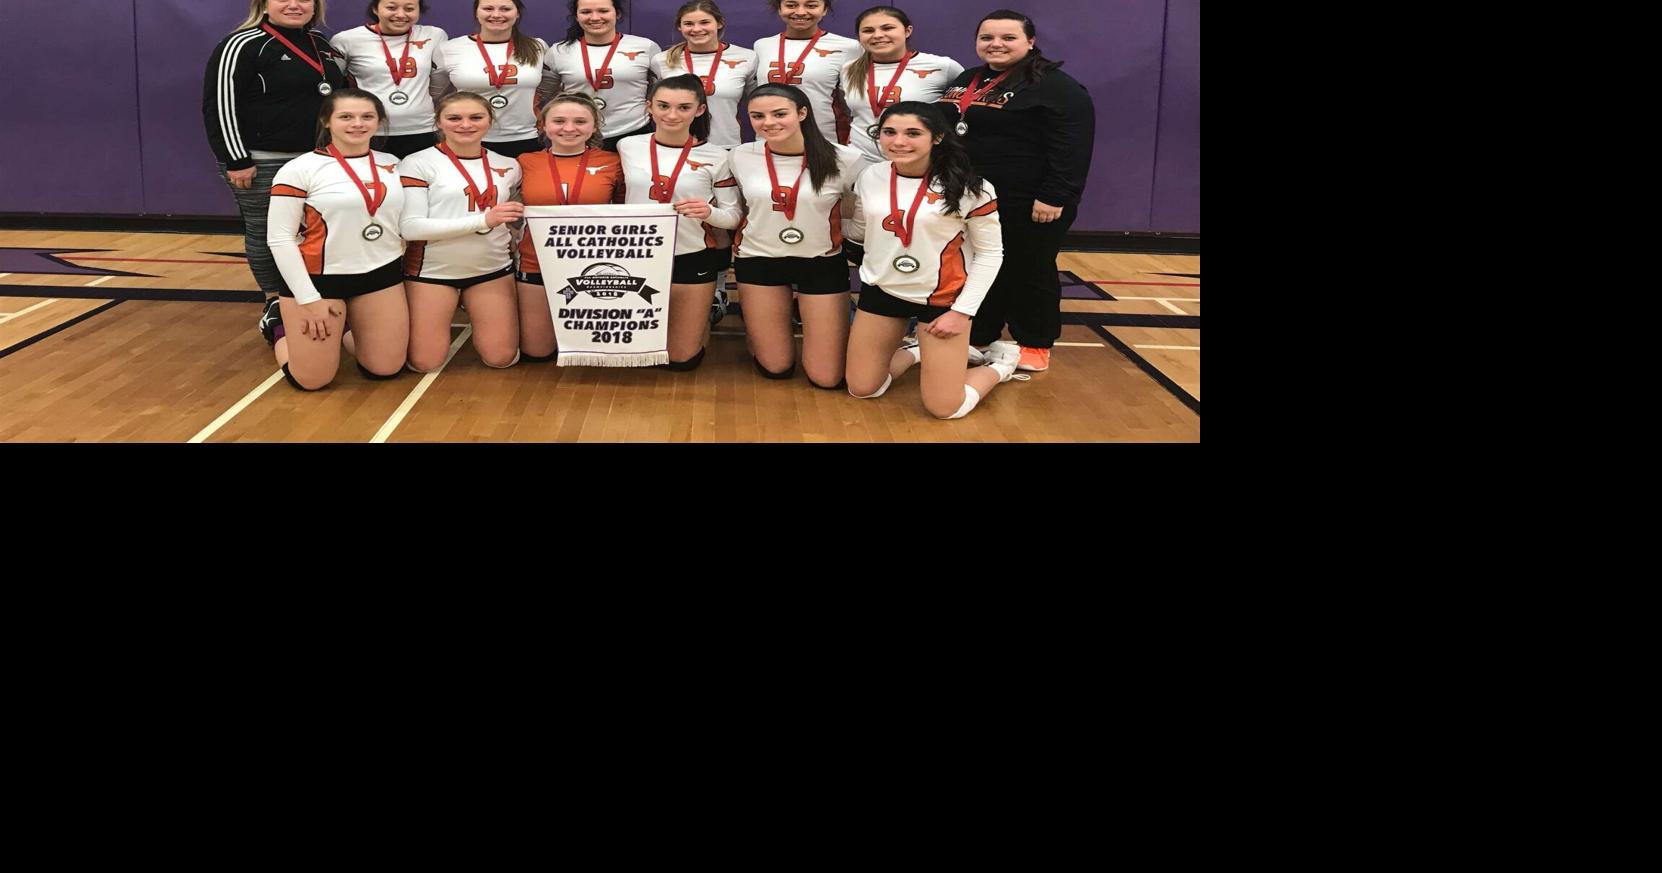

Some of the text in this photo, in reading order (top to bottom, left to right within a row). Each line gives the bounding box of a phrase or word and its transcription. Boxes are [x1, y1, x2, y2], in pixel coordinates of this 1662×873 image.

[483, 64, 518, 86] 12
[771, 185, 797, 211] 9
[548, 224, 658, 236] SENIOR GIRLS
[544, 235, 664, 247] ALL CATHOLICS
[556, 248, 654, 259] VOLLEYBALL
[558, 308, 632, 319] DIVISION
[563, 319, 659, 331] CHAMPIONS
[591, 331, 633, 344] 2018
